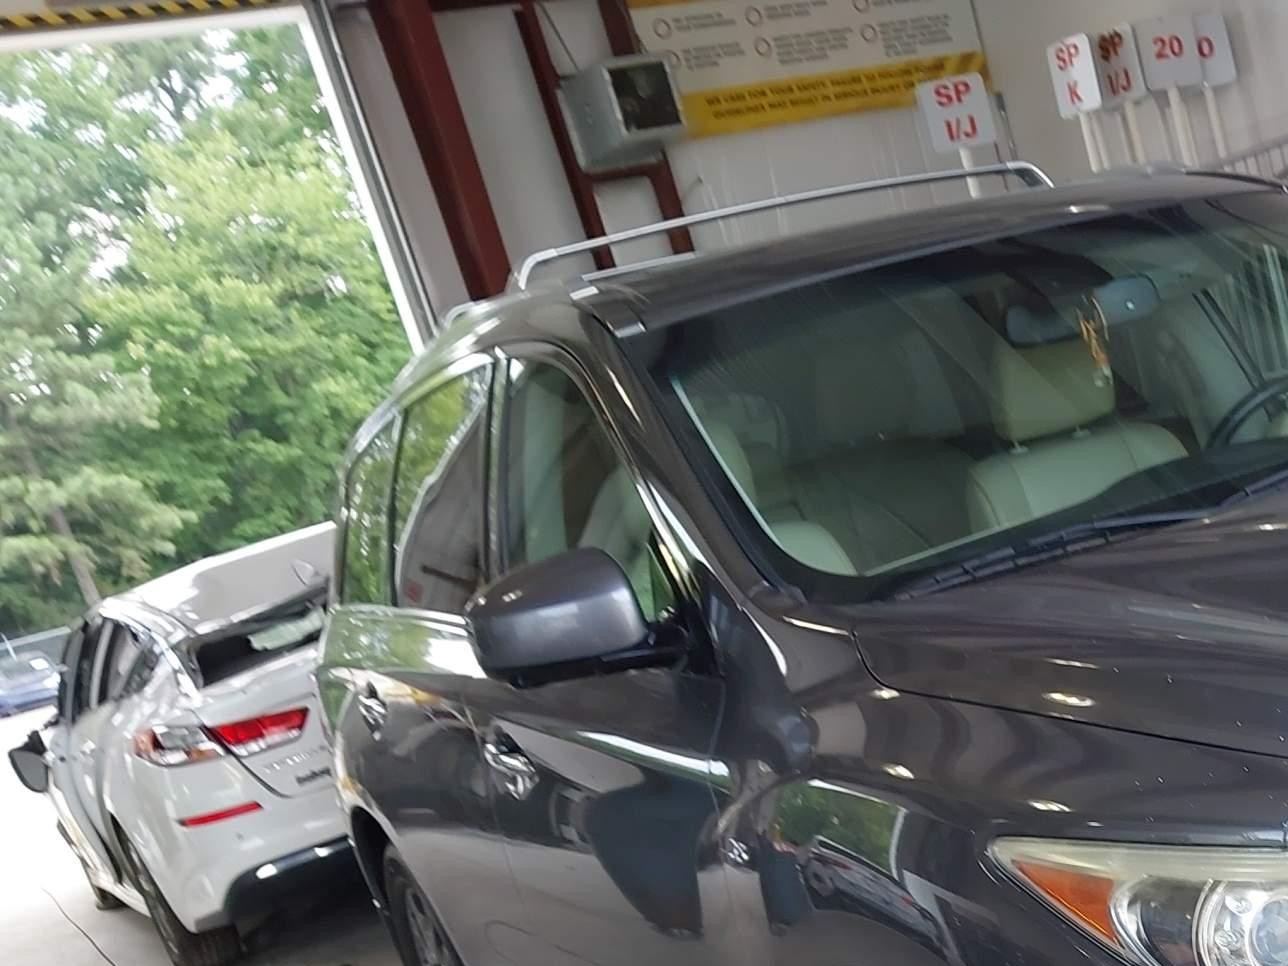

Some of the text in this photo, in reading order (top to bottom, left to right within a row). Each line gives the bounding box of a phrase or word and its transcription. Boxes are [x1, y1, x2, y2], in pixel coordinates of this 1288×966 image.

[1055, 43, 1079, 71] SP
[1098, 30, 1123, 62] SP
[1153, 35, 1184, 60] 20
[934, 80, 971, 107] SP
[1067, 80, 1083, 104] K
[945, 114, 977, 141] I/J
